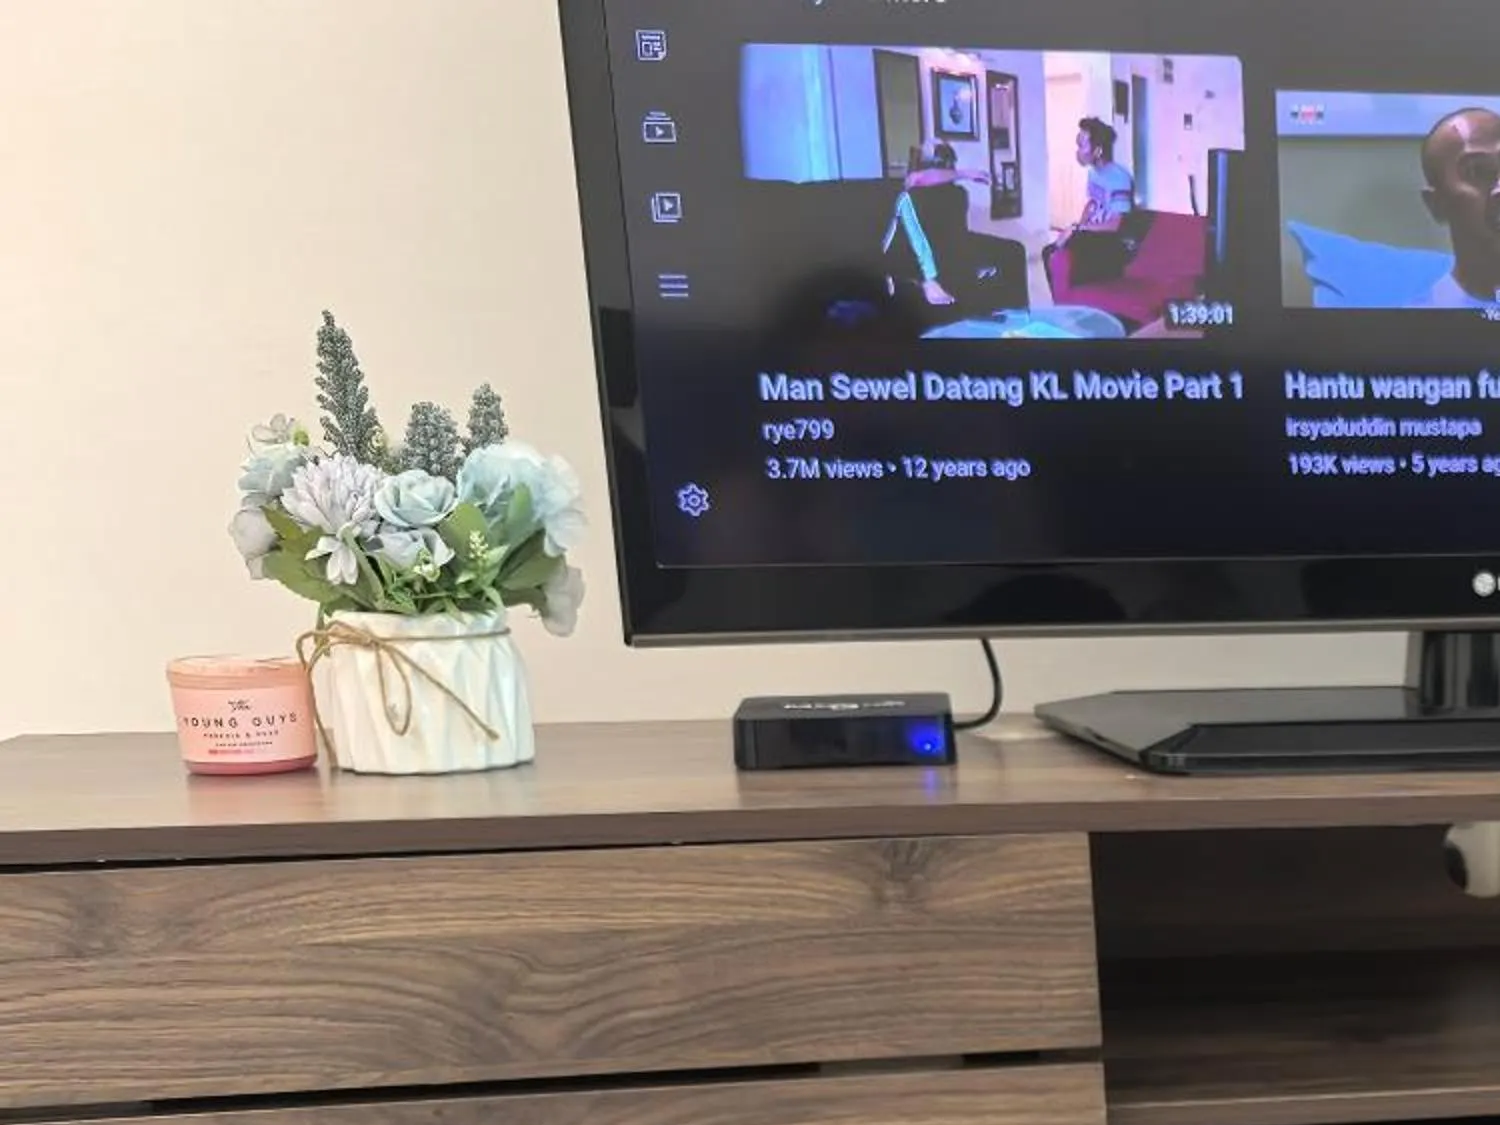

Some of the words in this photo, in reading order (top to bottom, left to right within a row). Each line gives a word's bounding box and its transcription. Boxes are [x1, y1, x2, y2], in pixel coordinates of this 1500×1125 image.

[1169, 302, 1233, 325] 1:39:01
[758, 373, 824, 401] Man
[830, 370, 917, 401] Sewel
[923, 370, 1023, 407] Datang
[1029, 370, 1069, 401] KL
[1073, 369, 1159, 400] Movie
[1164, 369, 1223, 400] Part
[1229, 370, 1244, 400] 1
[1285, 369, 1365, 400] Hantu
[1370, 374, 1472, 405] wangan
[763, 418, 835, 444] rye799
[1400, 416, 1483, 440] mustapa
[766, 456, 820, 479] 3.7M
[824, 457, 884, 479] views
[902, 456, 928, 479] 12
[931, 458, 988, 482] years
[991, 457, 1031, 481] ago
[1288, 453, 1339, 475] 193K
[1341, 454, 1396, 475] views
[1411, 453, 1424, 474] 5
[1427, 455, 1479, 477] years
[183, 716, 238, 729] YOUNG
